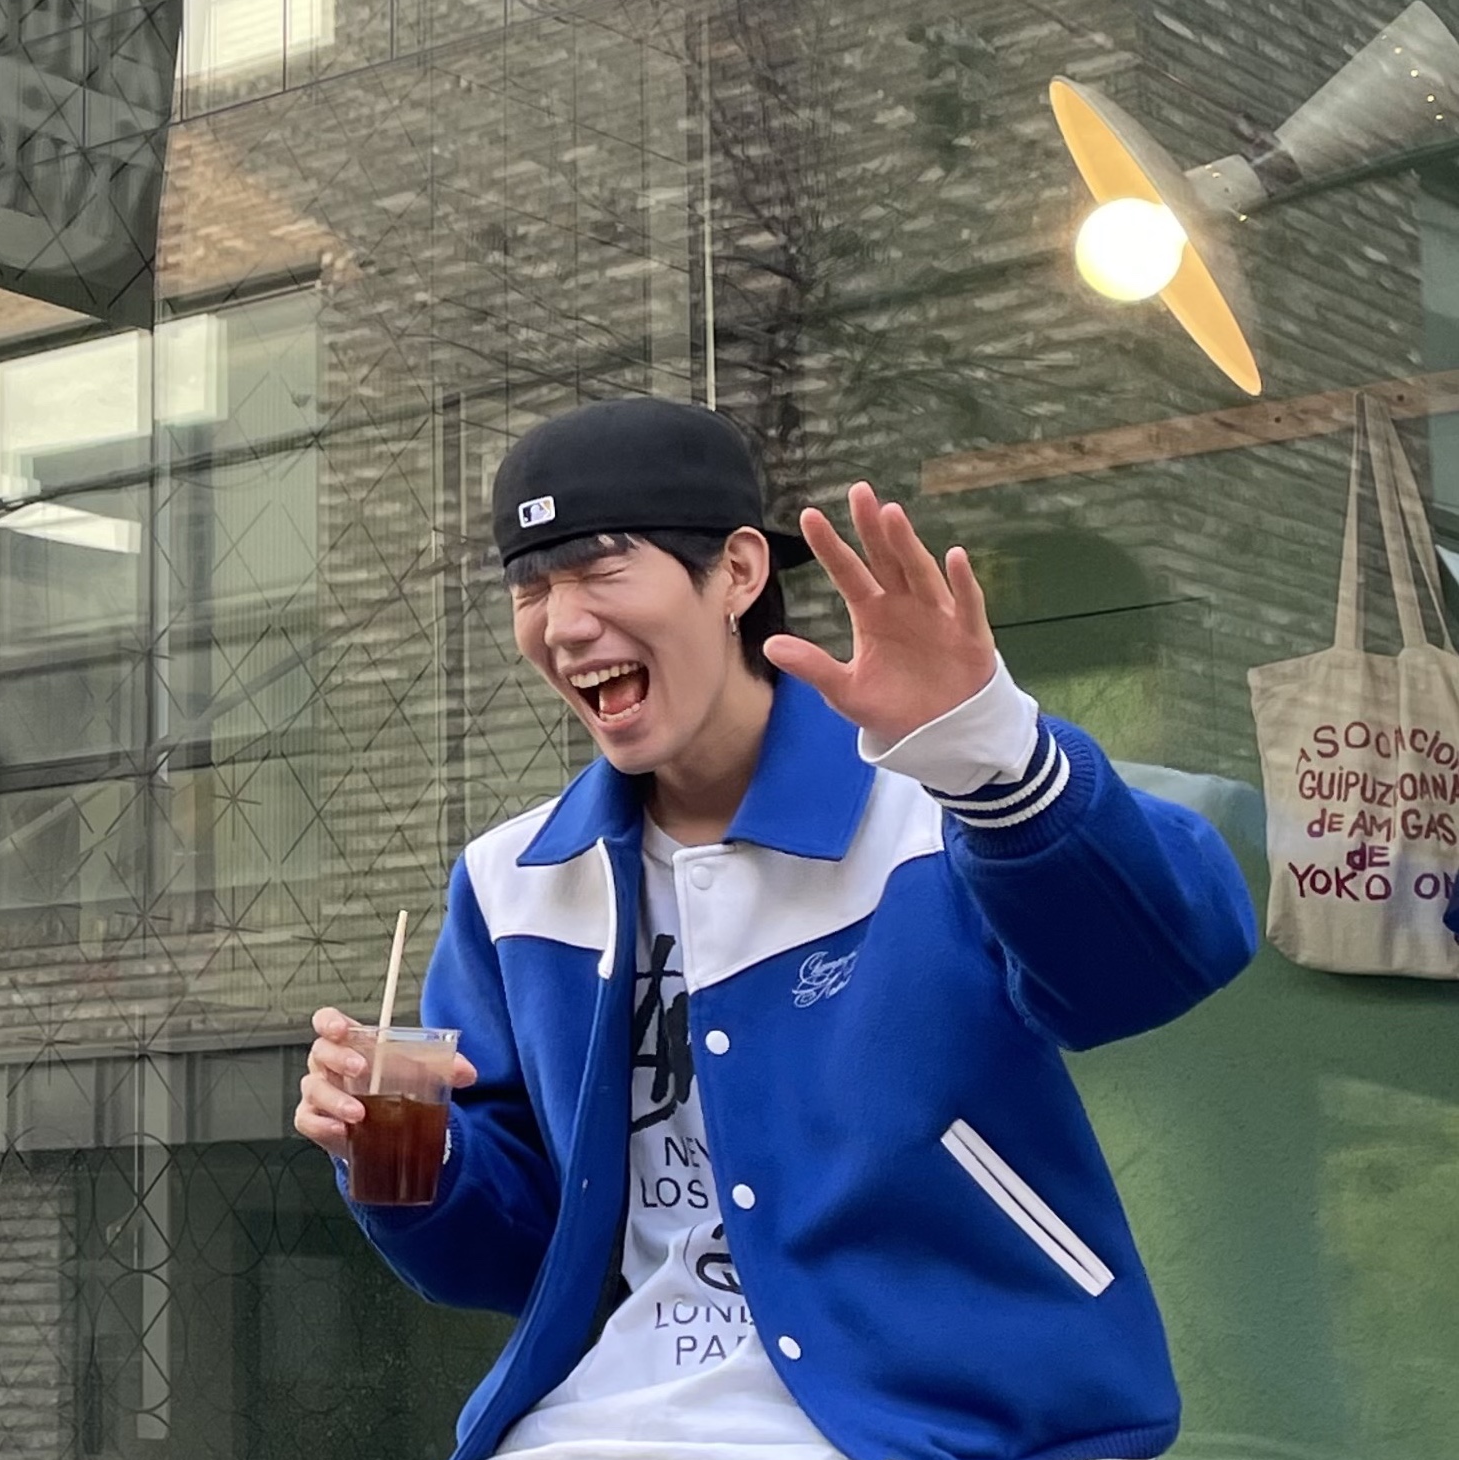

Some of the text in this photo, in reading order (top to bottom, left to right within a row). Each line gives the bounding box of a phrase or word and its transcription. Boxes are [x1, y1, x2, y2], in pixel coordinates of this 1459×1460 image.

[1287, 861, 1393, 902] YOKO
[640, 1176, 709, 1209] LOS
[675, 1333, 748, 1366] PA
